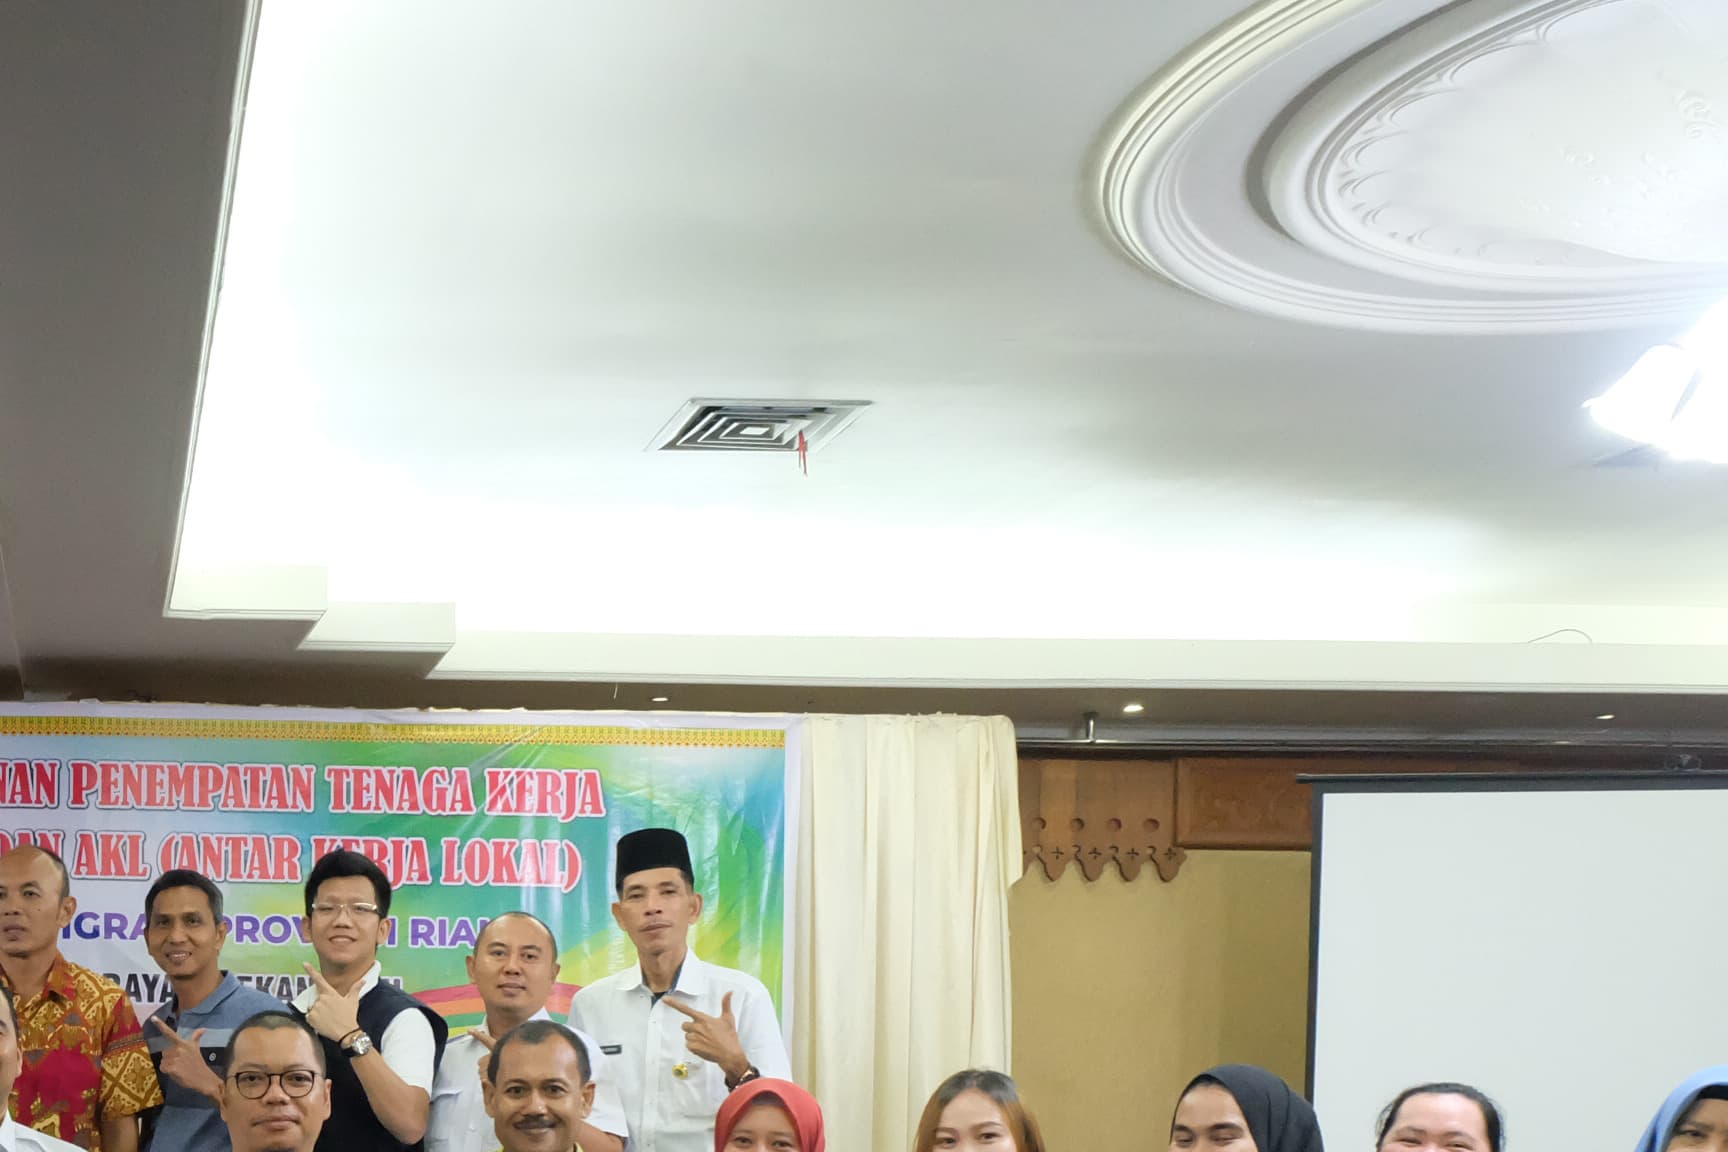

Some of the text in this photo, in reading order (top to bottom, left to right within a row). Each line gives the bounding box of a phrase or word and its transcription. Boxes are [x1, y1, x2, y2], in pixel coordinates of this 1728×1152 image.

[70, 761, 315, 811] PENEMPATAN
[326, 766, 475, 814] TENAGA
[485, 768, 605, 821] KERJA
[74, 833, 149, 878] AKL
[160, 835, 300, 881] (ANTAR
[442, 839, 582, 891] LOKAL)
